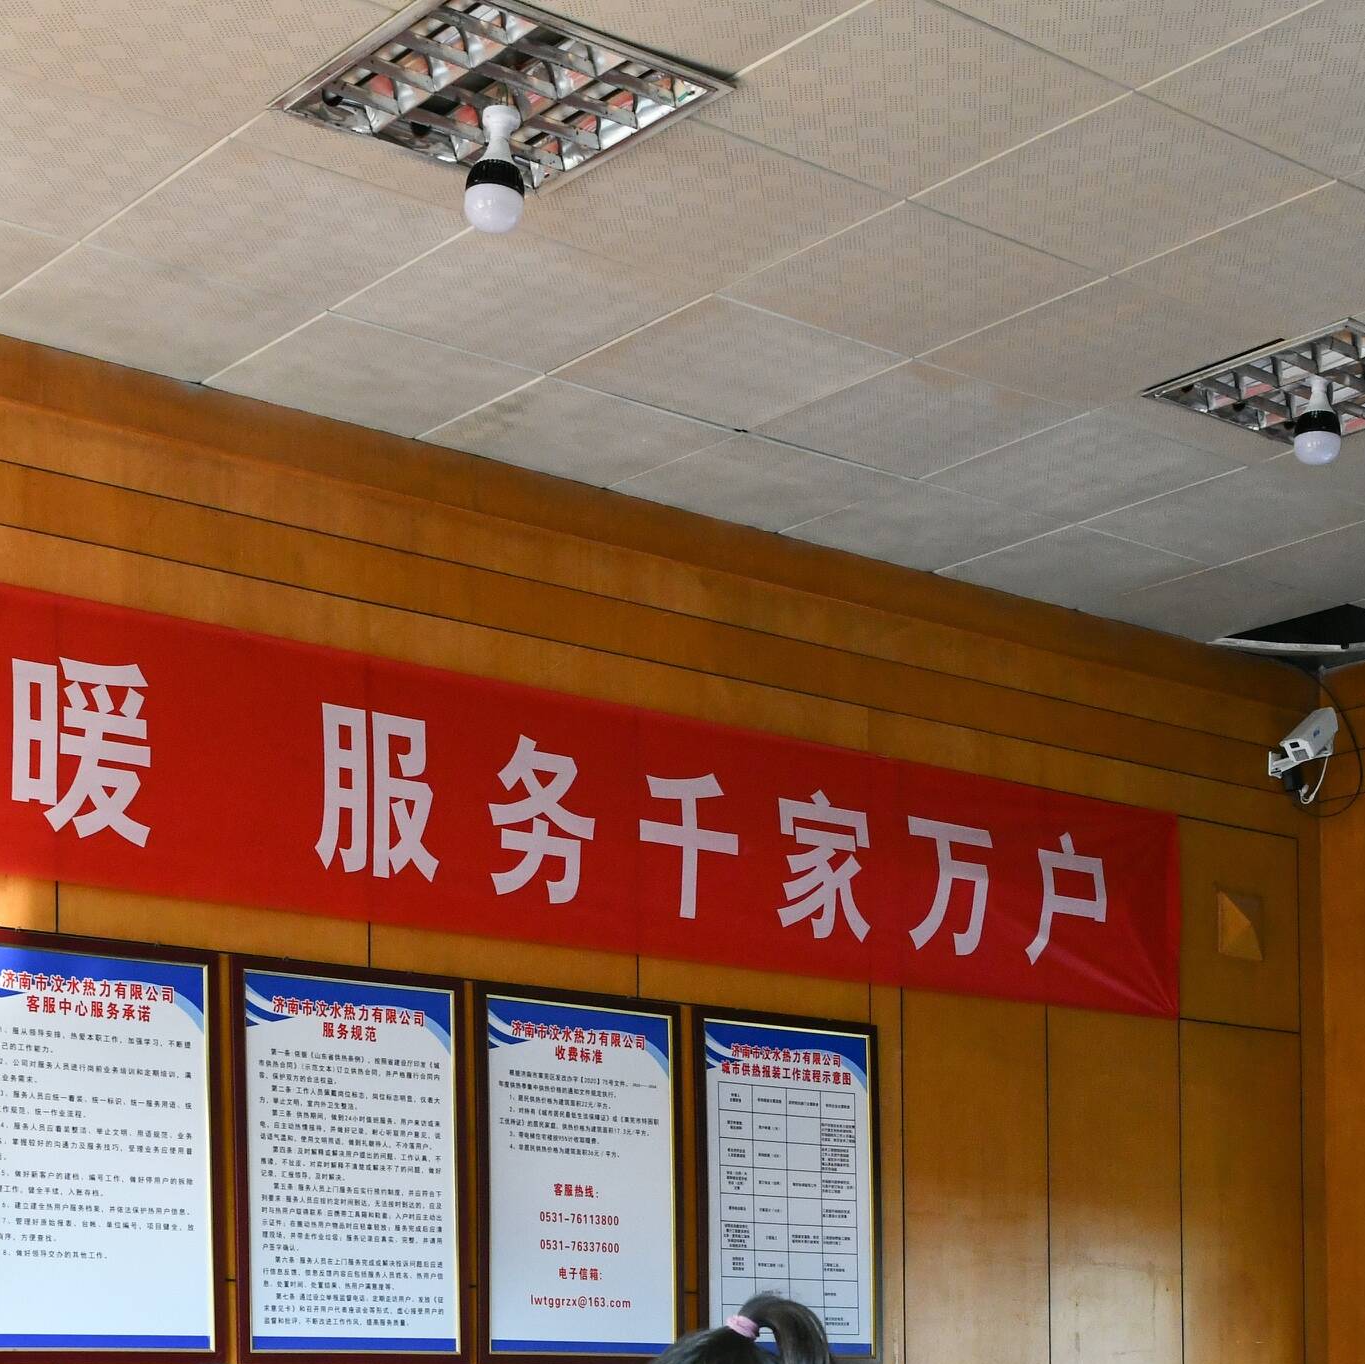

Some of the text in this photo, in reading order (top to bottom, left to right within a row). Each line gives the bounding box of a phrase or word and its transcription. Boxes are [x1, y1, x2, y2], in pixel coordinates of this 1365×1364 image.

[315, 702, 1107, 966] 服务千家万户
[2, 969, 174, 1005] 济南市汶水热力有限公司
[26, 993, 150, 1024] 客服中心服务承诺
[272, 995, 425, 1027] 济南市汶水热力有限公司
[322, 1020, 377, 1043] 服务规范
[511, 1020, 646, 1051] 济南市汶水热力有限公司
[555, 1044, 603, 1064] 收费标准
[731, 1043, 841, 1069] 济南市汶水热力有限公司
[721, 1059, 851, 1087] 城市供热报装工作流程示意图
[539, 1211, 620, 1227] 0531-76113800
[540, 1239, 620, 1254] 0531-76337600
[530, 1293, 631, 1310] lwtggrzx@163.com
